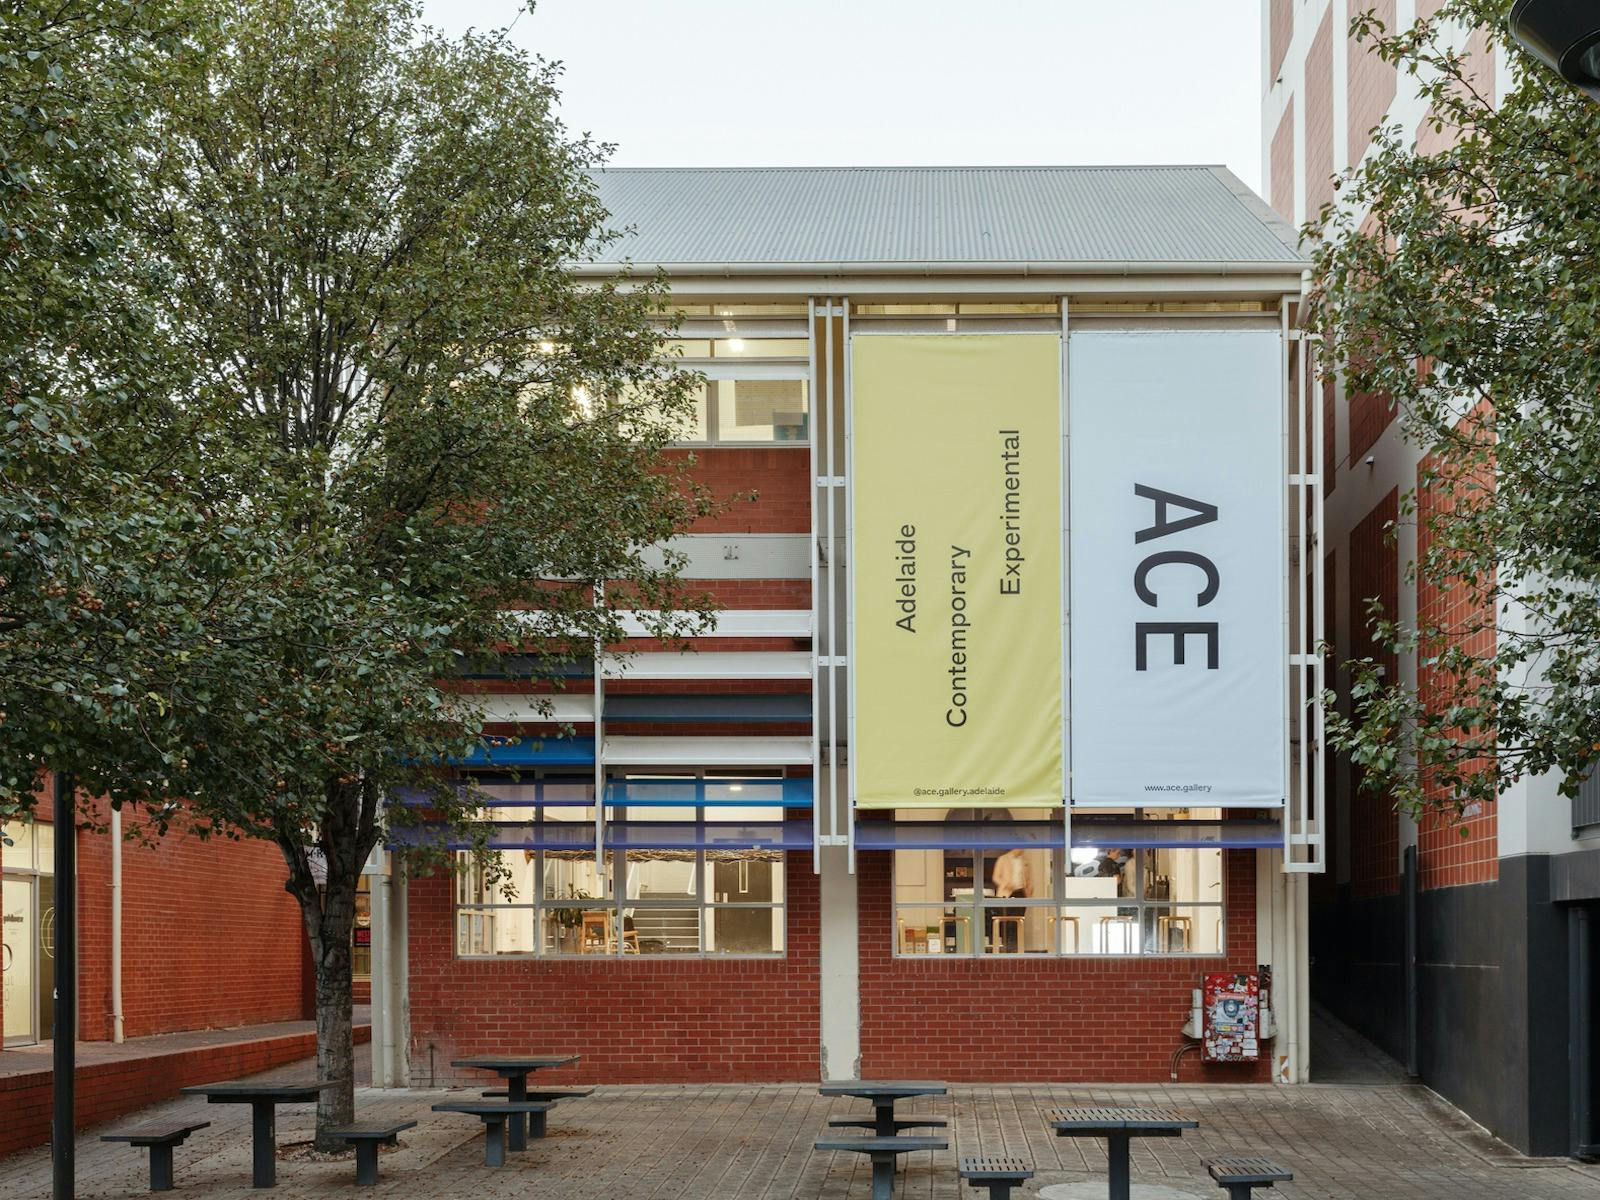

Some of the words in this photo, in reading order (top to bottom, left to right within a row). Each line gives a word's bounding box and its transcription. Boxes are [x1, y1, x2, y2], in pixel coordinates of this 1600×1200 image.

[895, 524, 917, 634] Adelaide
[998, 430, 1025, 595] Experimental
[1133, 482, 1220, 672] ACE
[945, 544, 971, 728] Contemporary
[913, 787, 1006, 797] @ace.gallery.adelaide
[1144, 783, 1213, 793] www.ace.gallery
